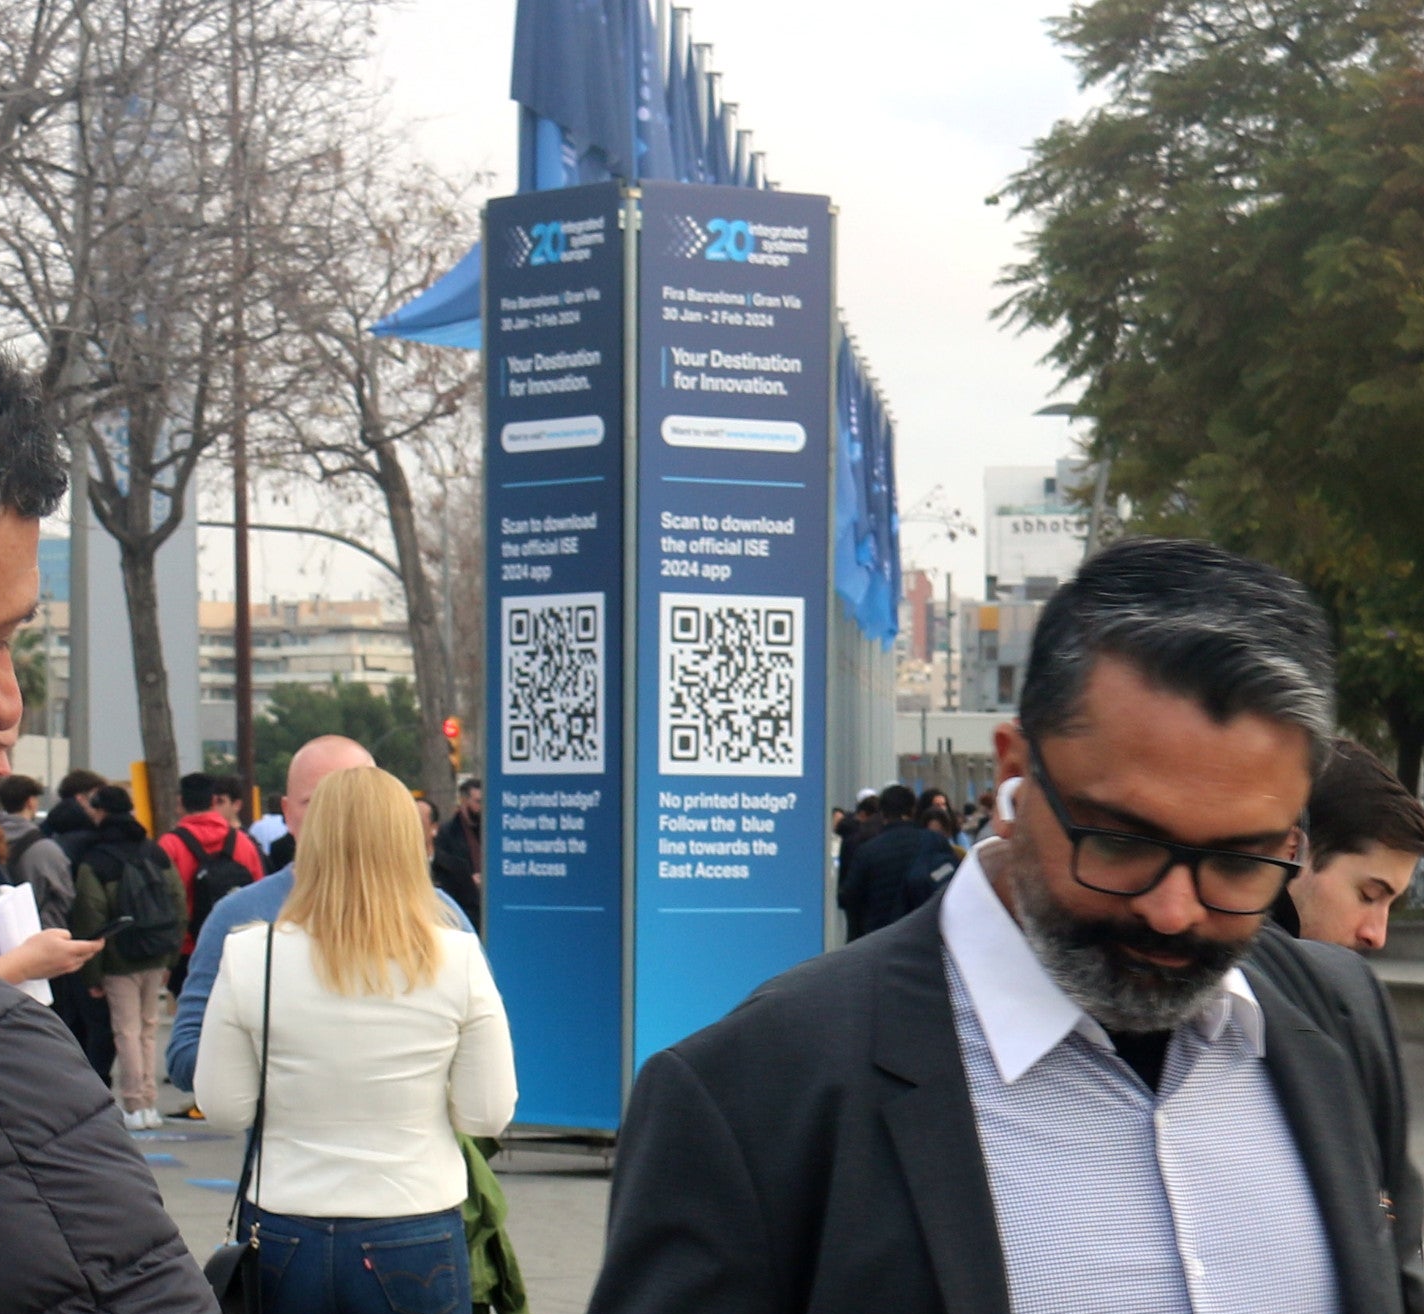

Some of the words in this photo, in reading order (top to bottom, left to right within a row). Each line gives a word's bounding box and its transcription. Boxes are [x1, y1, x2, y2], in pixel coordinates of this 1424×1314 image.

[705, 217, 756, 262] 20
[748, 221, 809, 240] integrated
[530, 220, 566, 266] 20
[761, 239, 808, 254] systems
[747, 253, 790, 267] europe
[662, 285, 685, 301] Fira
[686, 287, 745, 306] Barcelona
[752, 292, 781, 308] Gran
[781, 294, 802, 309] Via
[662, 306, 678, 321] 30
[679, 308, 702, 322] Jan
[710, 310, 719, 324] 2
[721, 311, 744, 325] Feb
[745, 312, 774, 327] 2024
[507, 356, 533, 374] Your
[534, 348, 601, 372] Destination
[671, 346, 708, 368] Your
[710, 349, 802, 373] Destination
[509, 378, 526, 397] for
[673, 371, 698, 390] for
[700, 373, 788, 396] Innovation.
[501, 517, 528, 535] Scan
[530, 517, 542, 533] to
[543, 512, 597, 533] download
[660, 511, 700, 530] Scan
[702, 515, 718, 531] to
[720, 514, 795, 535] download
[501, 541, 520, 558] the
[521, 538, 559, 557] official
[560, 535, 579, 554] ISE
[660, 536, 687, 554] the
[689, 537, 742, 556] official
[744, 538, 770, 557] ISE
[501, 563, 529, 580] 2024
[530, 564, 553, 582] app
[660, 559, 699, 577] 2024
[701, 563, 732, 582] app
[502, 791, 518, 808] No
[519, 791, 558, 811] printed
[560, 790, 601, 811] badge?
[658, 791, 681, 808] No
[683, 792, 739, 813] printed
[741, 791, 797, 814] badge?
[502, 813, 536, 831] Follow
[538, 814, 556, 831] the
[560, 814, 585, 831] blue
[659, 814, 708, 832] Follow
[710, 815, 736, 832] the
[741, 815, 774, 833] blue
[502, 836, 522, 853] line
[523, 837, 567, 853] towards
[568, 837, 587, 854] the
[658, 838, 687, 855] line
[689, 837, 751, 856] towards
[752, 838, 778, 856] the
[502, 859, 526, 876] East
[527, 860, 567, 877] Access
[658, 861, 693, 878] East
[694, 861, 749, 879] Access
